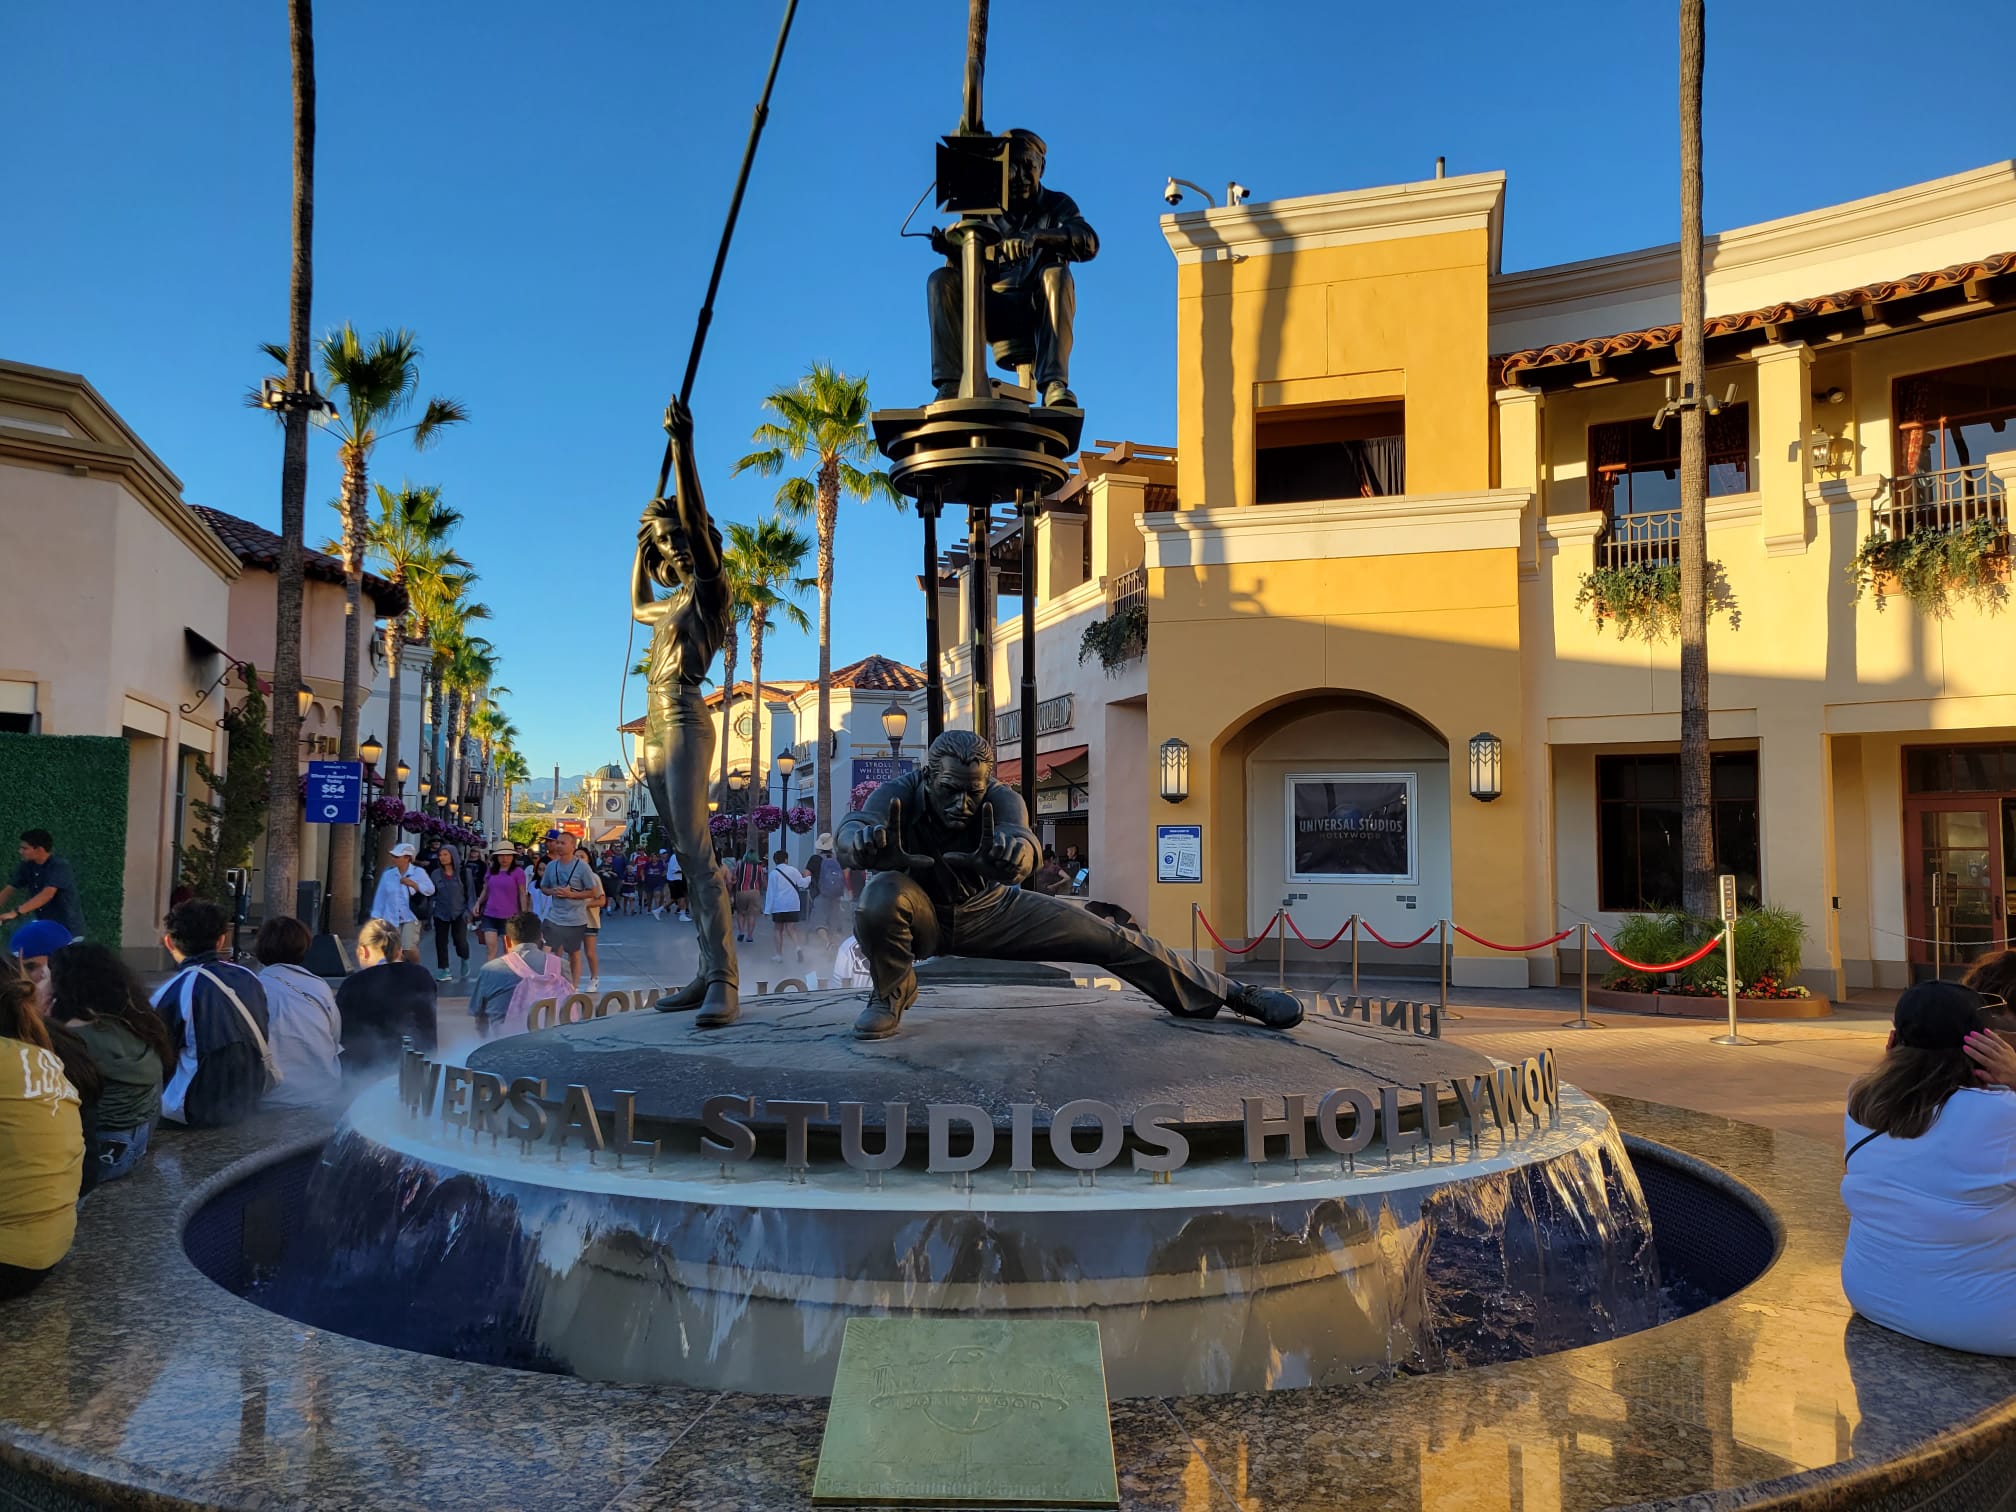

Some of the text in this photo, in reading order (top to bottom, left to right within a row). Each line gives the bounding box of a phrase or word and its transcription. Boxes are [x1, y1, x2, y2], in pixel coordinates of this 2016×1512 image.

[321, 784, 346, 794] $64
[1299, 818, 1403, 832] UNIVERSAL STUDIOS
[1319, 832, 1382, 840] HOLLYWOOD
[700, 1094, 1191, 1173] STUDIOS
[1241, 1048, 1559, 1162] HOLLYWOO
